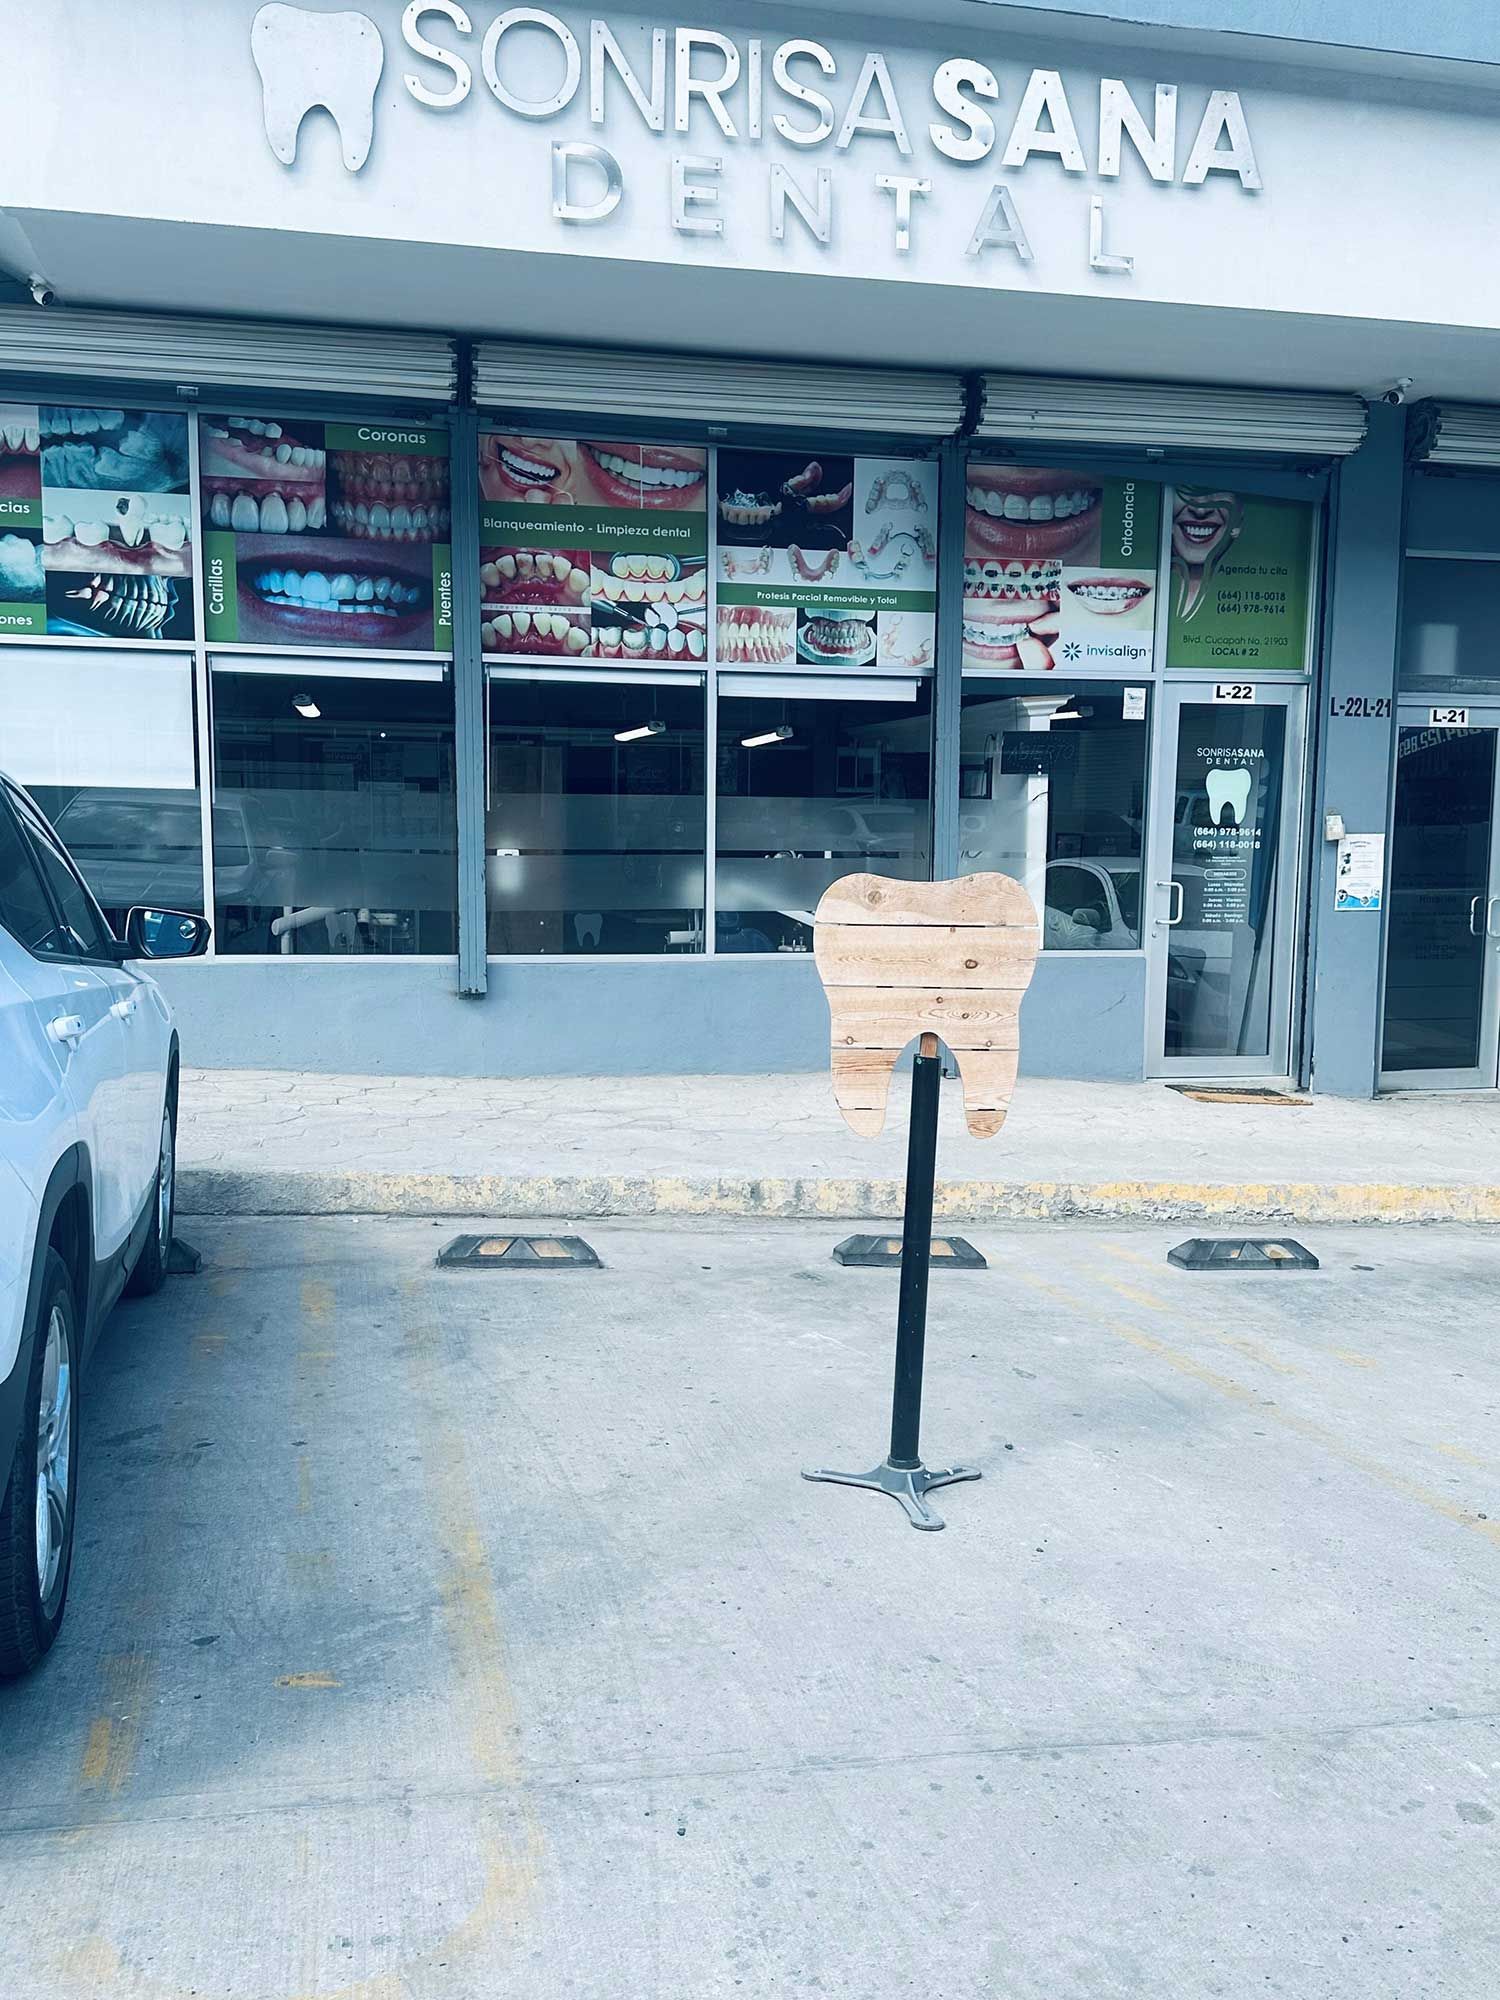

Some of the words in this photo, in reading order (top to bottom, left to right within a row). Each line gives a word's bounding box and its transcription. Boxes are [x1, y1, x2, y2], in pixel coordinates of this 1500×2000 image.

[550, 139, 1134, 273] DENTAL
[357, 427, 427, 444] Coronas
[1120, 482, 1135, 556] Ortodoncia
[483, 518, 585, 533] Blanqueamiento
[597, 524, 649, 537] Limpieza
[652, 527, 691, 538] dental
[1218, 565, 1256, 576] Agenda
[1258, 566, 1268, 575] tu
[1270, 566, 1288, 575] cita
[208, 557, 224, 615] Carillas
[438, 571, 452, 626] Puentes
[756, 591, 790, 600] Protesis
[792, 593, 822, 601] Parcial
[823, 594, 868, 603] Removible
[869, 597, 875, 605] y
[877, 596, 898, 605] Total
[1217, 591, 1241, 601] (664)
[1245, 591, 1286, 601] 118-0018
[1216, 603, 1240, 614] (664)
[1243, 604, 1286, 614] 978-9614
[1212, 647, 1240, 656] LOCAL
[1249, 648, 1259, 656] 22
[1215, 685, 1253, 699] L-22
[1432, 709, 1466, 723] L-21
[1206, 757, 1255, 765] DENTAL
[1193, 827, 1217, 837] (664)
[1219, 828, 1261, 837] 978-9614
[1192, 840, 1217, 850] (664)
[1218, 840, 1261, 849] 118-0018
